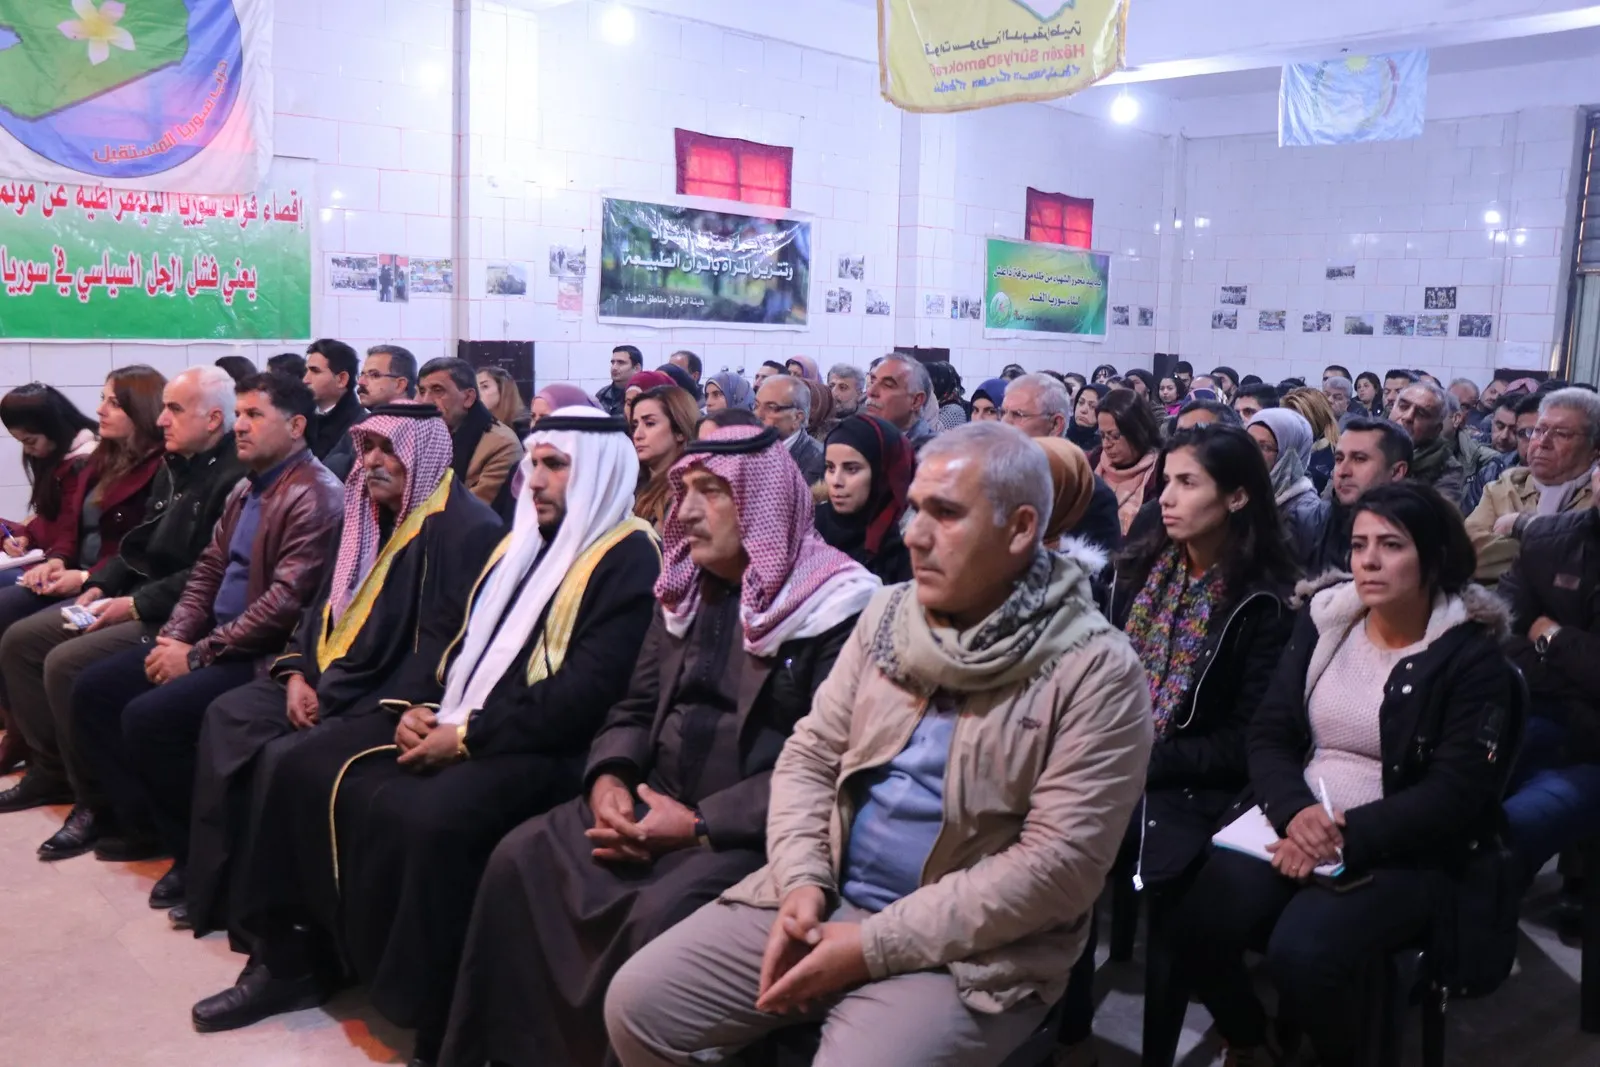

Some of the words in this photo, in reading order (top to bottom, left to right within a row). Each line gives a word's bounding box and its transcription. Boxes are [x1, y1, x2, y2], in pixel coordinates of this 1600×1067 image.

[210, 60, 228, 101] حزب
[177, 98, 216, 140] سوريا
[93, 131, 177, 164] المستقبل
[42, 181, 68, 218] عن
[263, 190, 304, 230] إقصاء
[1, 246, 49, 295] سوريا
[53, 245, 73, 296] في
[76, 251, 142, 302] السياسي
[147, 253, 182, 297] الحل
[187, 255, 219, 297] فشل
[620, 248, 680, 272] الطبيعة
[223, 259, 257, 304] يعني
[1048, 295, 1067, 307] سوريا
